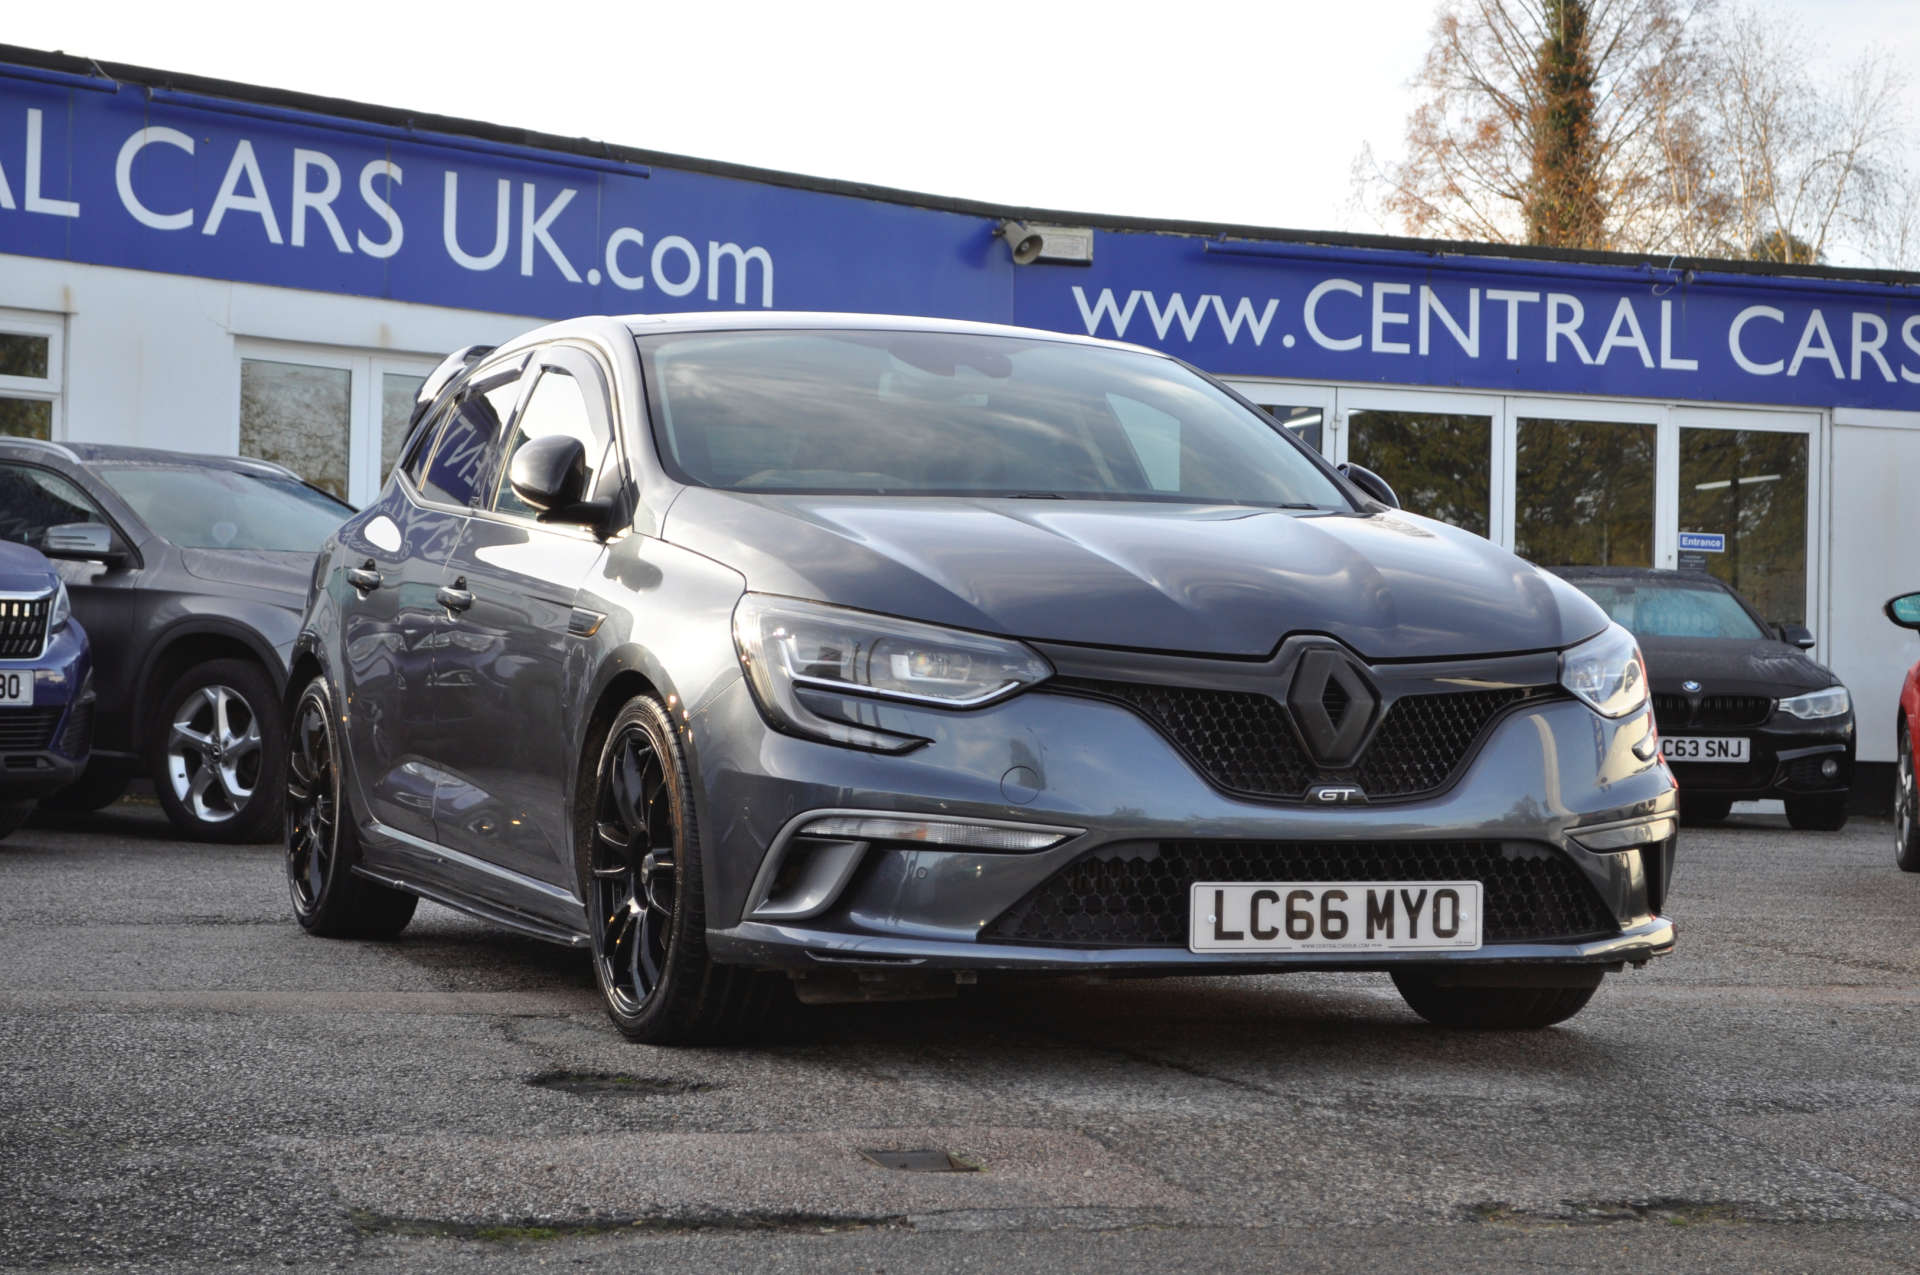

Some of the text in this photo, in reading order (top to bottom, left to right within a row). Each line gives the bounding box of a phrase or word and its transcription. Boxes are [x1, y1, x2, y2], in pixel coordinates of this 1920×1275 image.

[0, 108, 774, 308] L CARS UK.com
[1728, 305, 1920, 384] CARS
[1681, 536, 1721, 547] Entrance
[1661, 739, 1742, 759] C63 SNJ
[1318, 788, 1357, 801] GT
[1213, 888, 1460, 941] LC66 MYO
